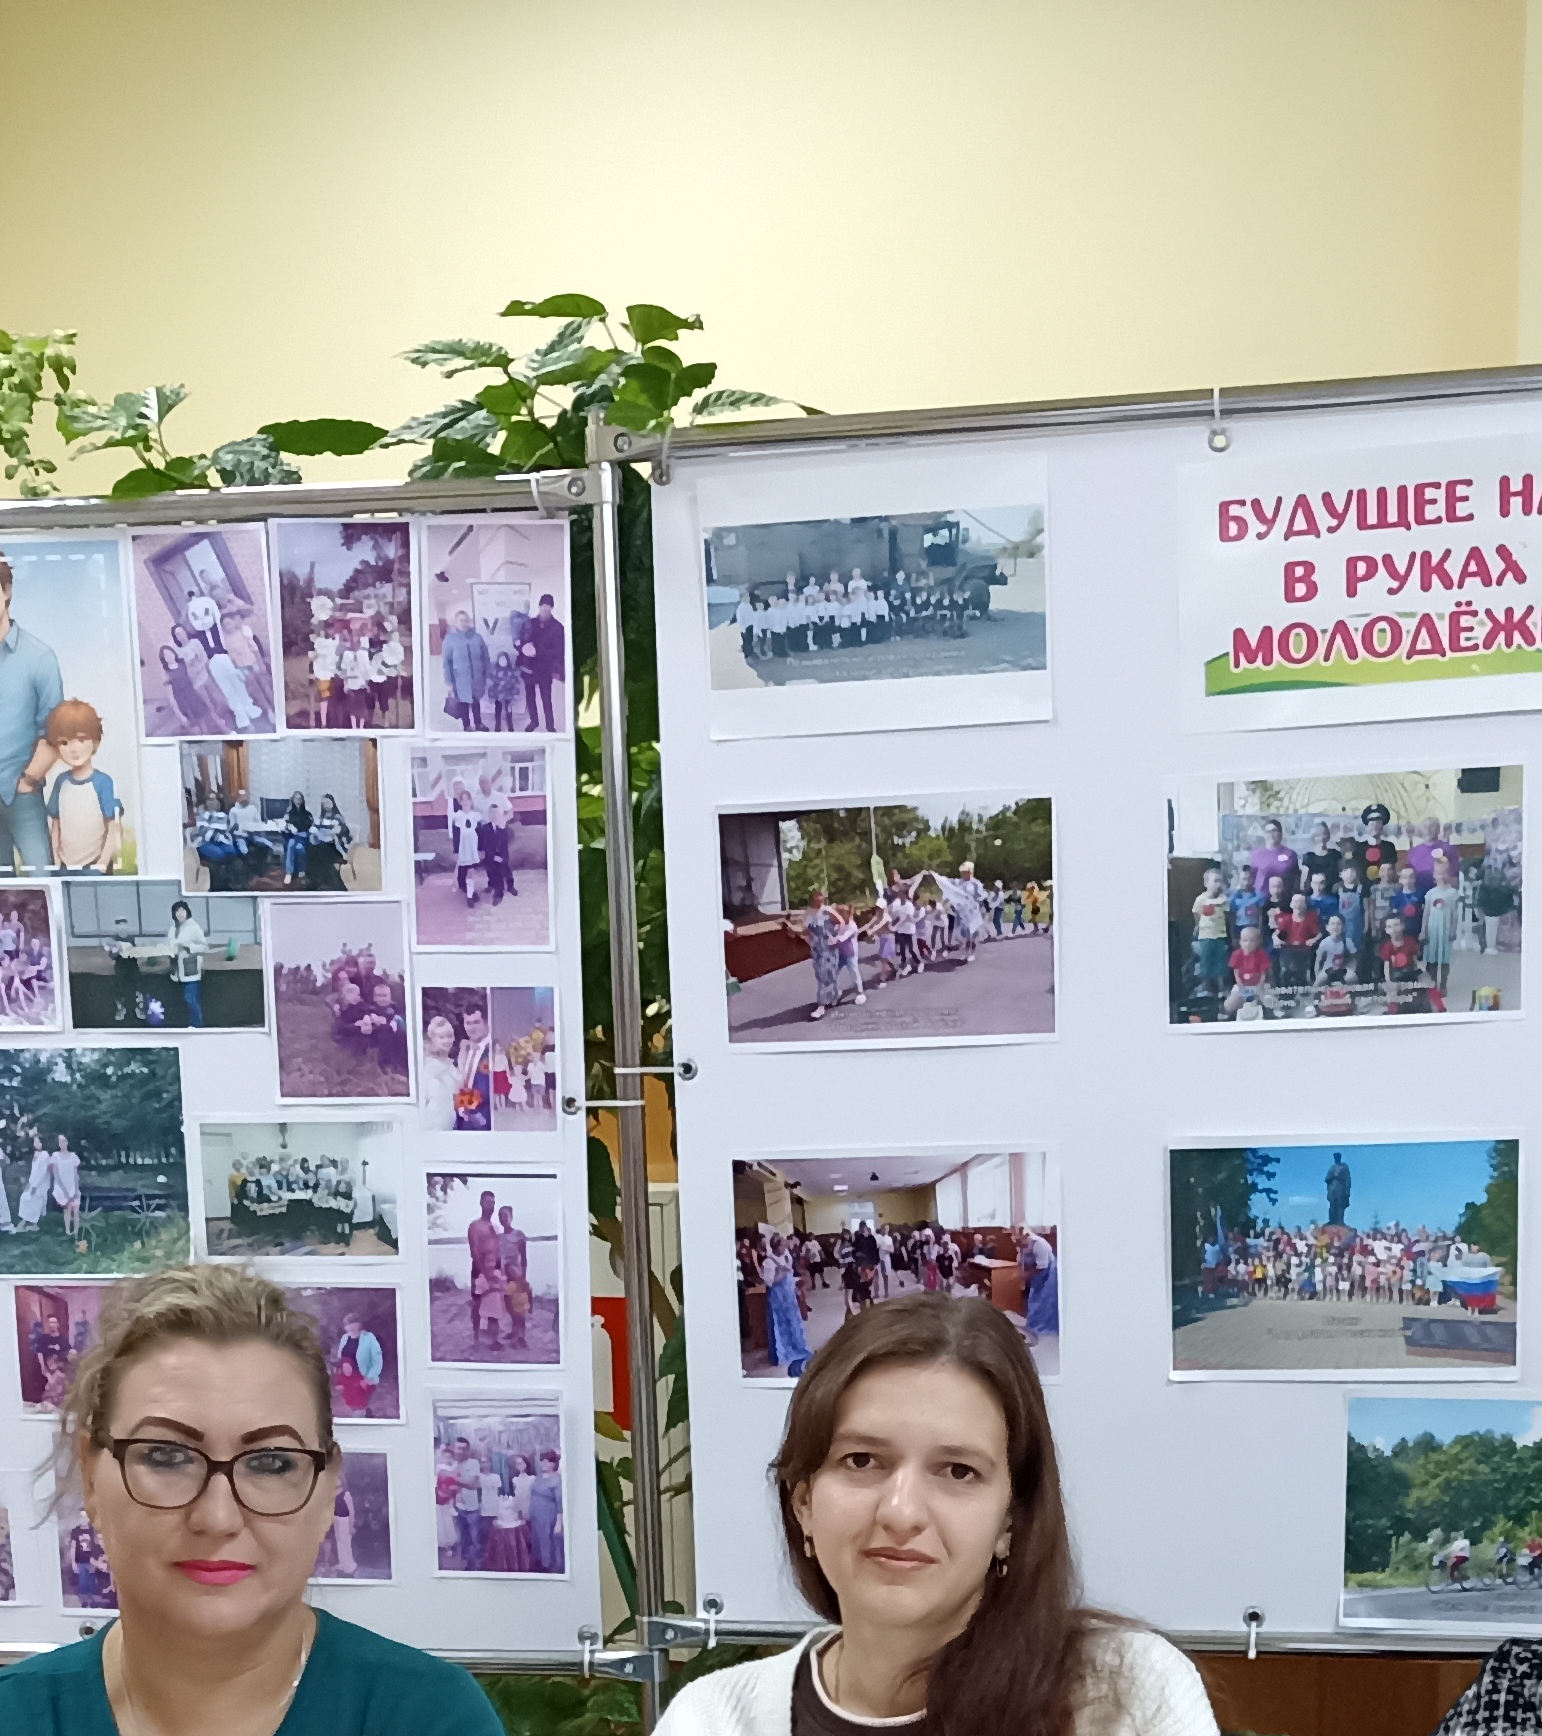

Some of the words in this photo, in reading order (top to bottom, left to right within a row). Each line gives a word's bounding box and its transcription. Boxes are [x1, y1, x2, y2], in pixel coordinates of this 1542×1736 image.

[1218, 478, 1474, 543] БУДУЩЕЕ
[1283, 560, 1318, 604] В
[1345, 543, 1527, 598] РУКАХ
